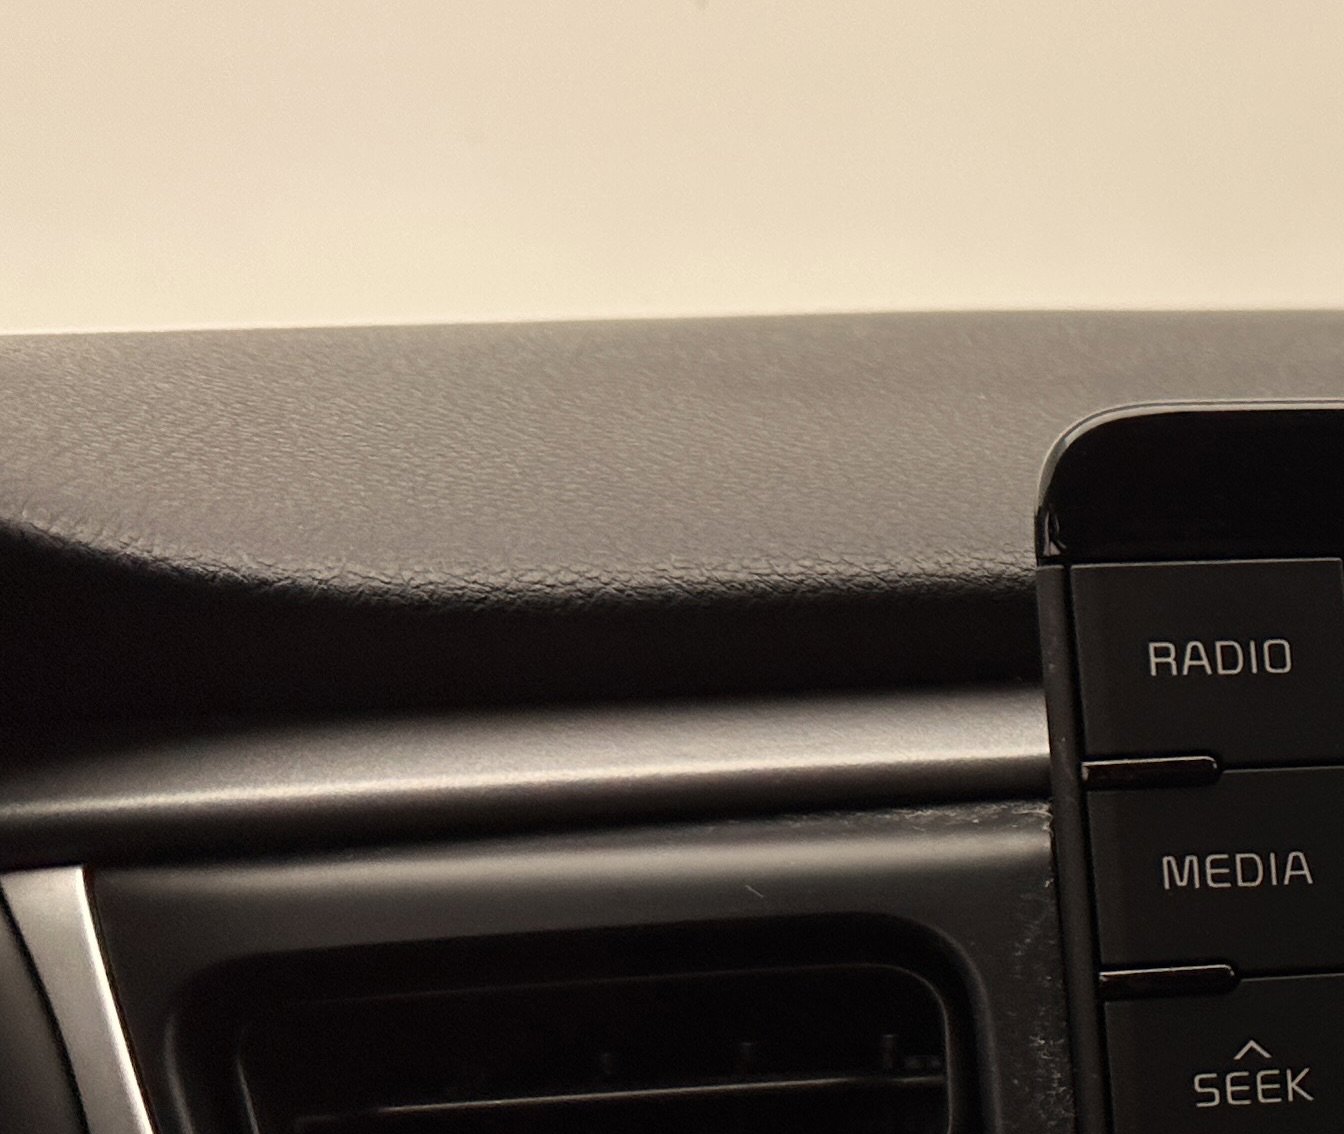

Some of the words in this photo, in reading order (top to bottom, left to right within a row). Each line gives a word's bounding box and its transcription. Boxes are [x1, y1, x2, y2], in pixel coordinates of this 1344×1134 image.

[1147, 638, 1293, 677] RADIO
[1160, 851, 1314, 890] MEDIA
[1193, 1068, 1314, 1108] SEEK
